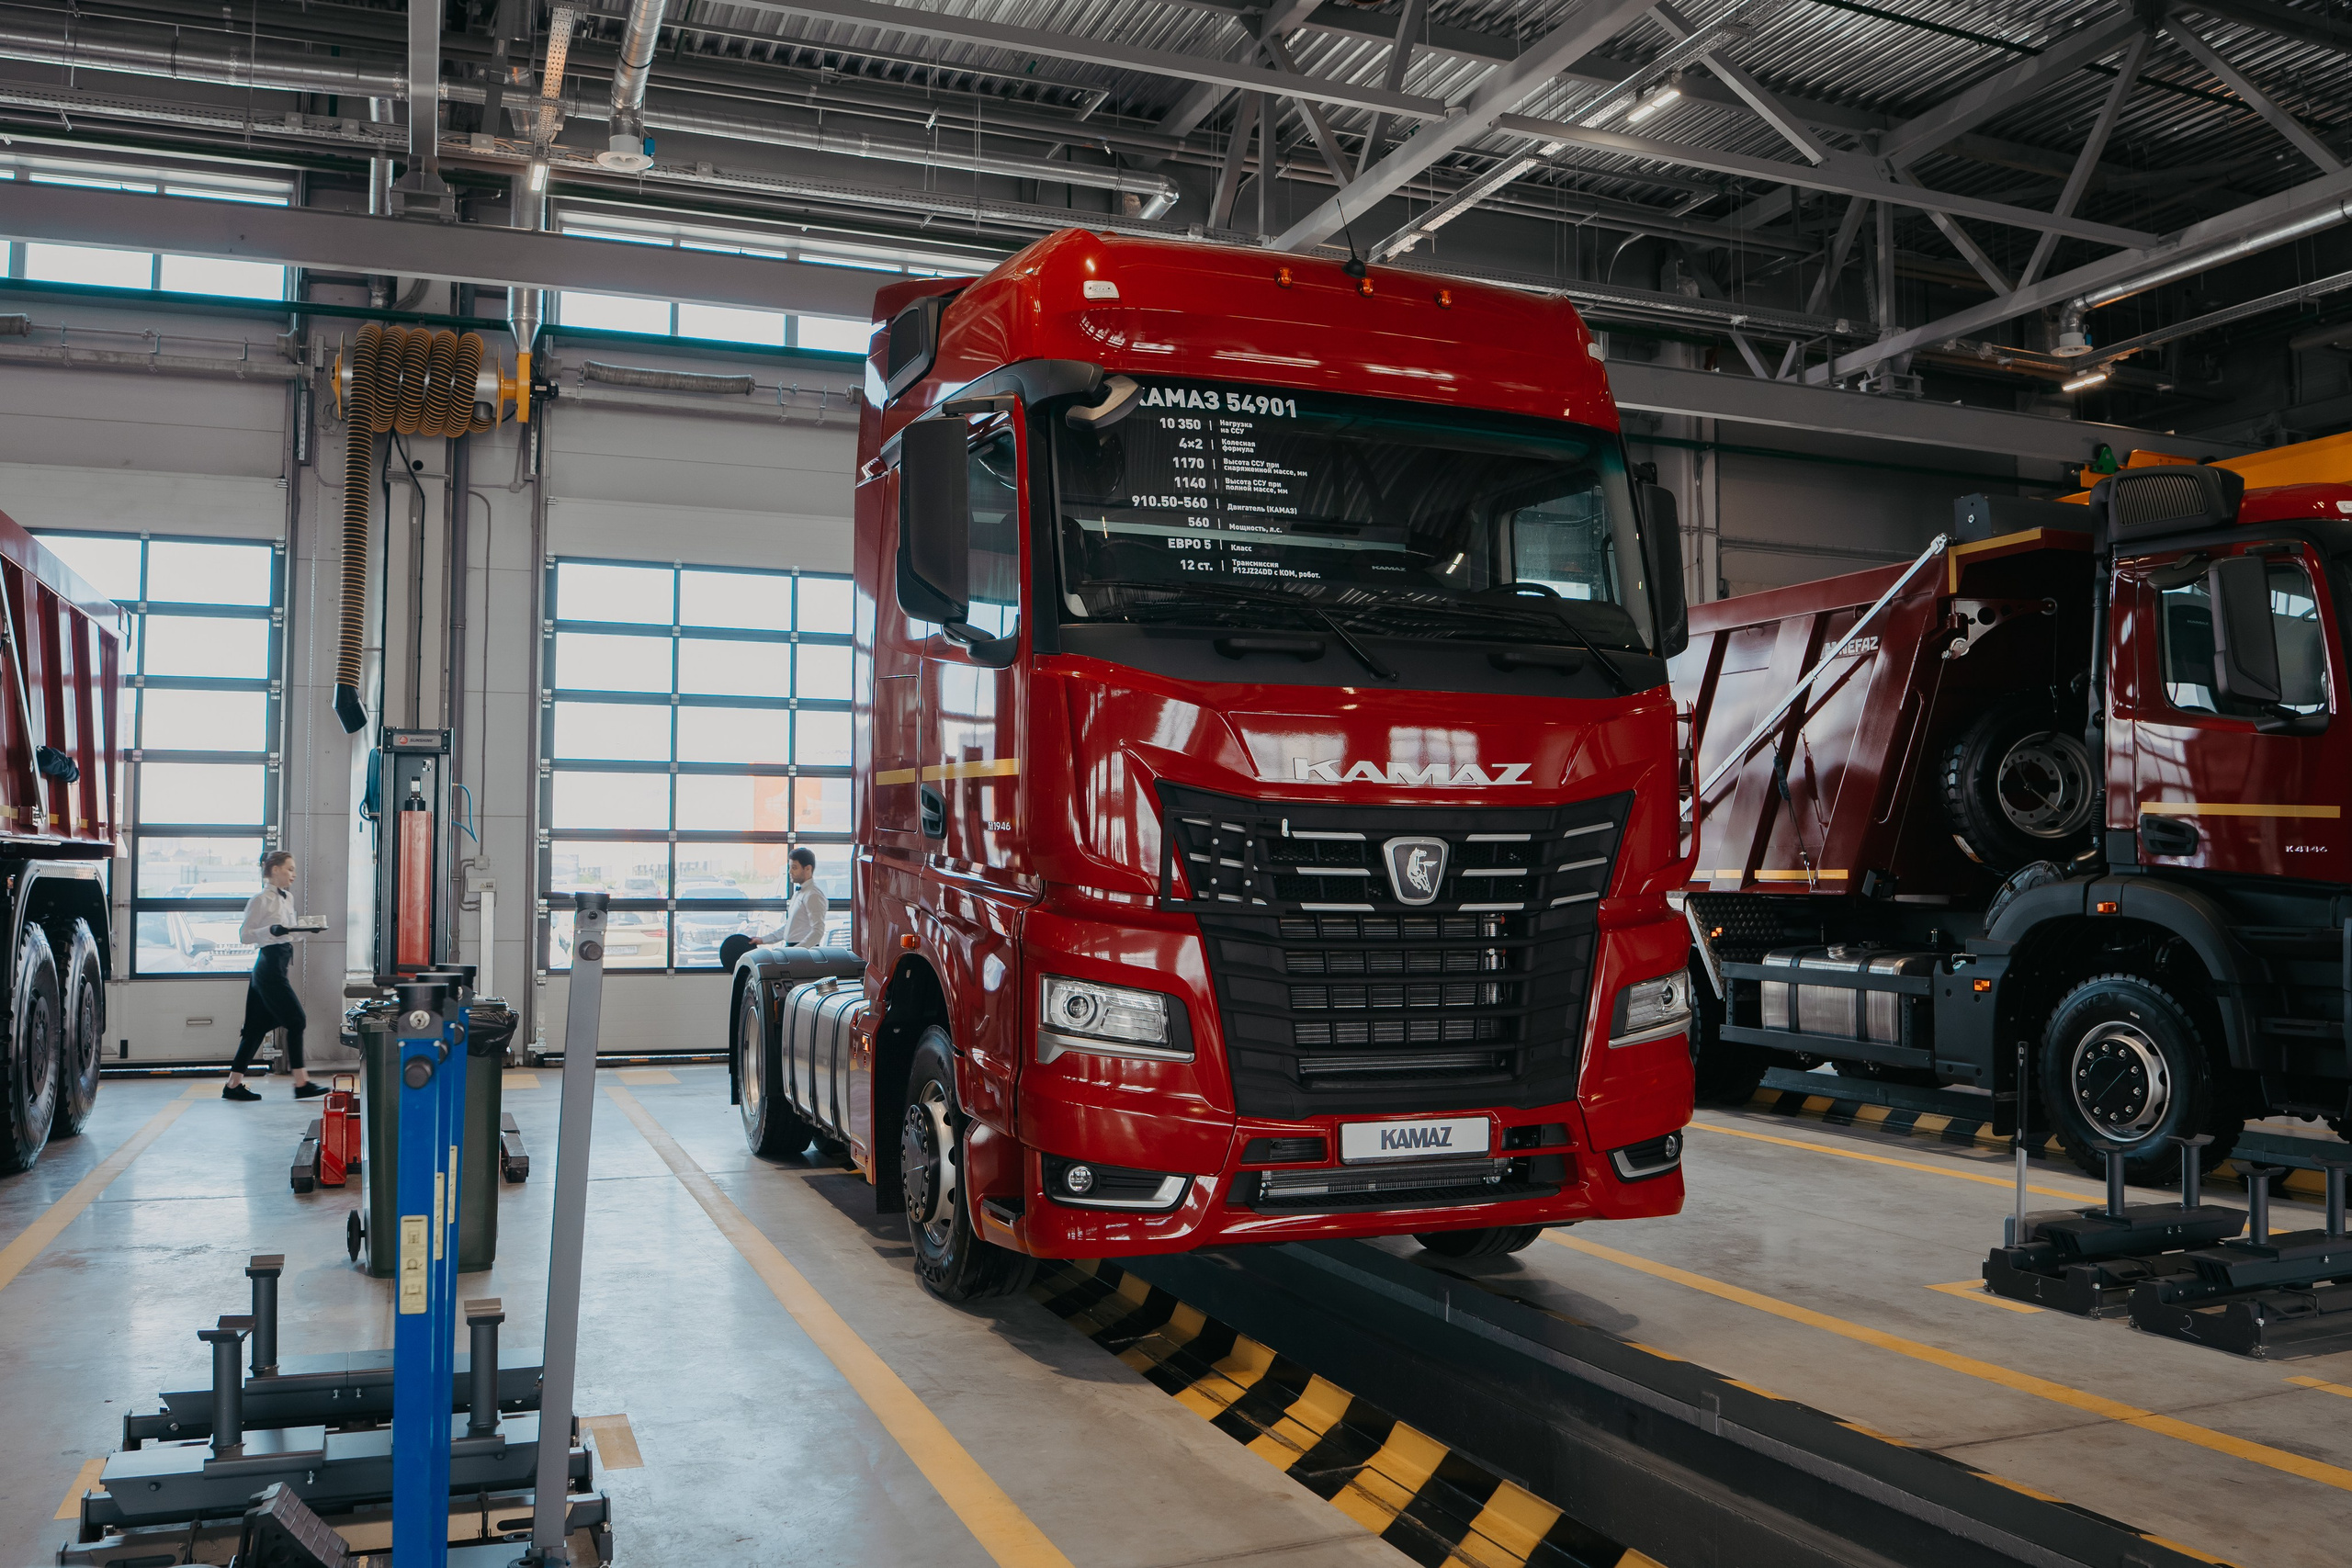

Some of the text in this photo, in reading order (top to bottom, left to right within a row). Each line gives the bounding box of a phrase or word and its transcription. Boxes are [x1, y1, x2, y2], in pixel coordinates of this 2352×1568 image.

[1226, 393, 1297, 418] 54901
[1160, 418, 1201, 430] 10 350
[1220, 420, 1253, 429] Нагрузка
[1222, 439, 1255, 447] Колесная
[1173, 457, 1204, 469] 1170
[1224, 465, 1272, 475] снаряженной
[1174, 477, 1206, 489] 1140
[1132, 495, 1208, 508] 910.50-560
[1227, 503, 1297, 515] Двигатель (КАМАЗ)
[1188, 517, 1209, 528] 560
[1229, 524, 1268, 533] Мощность,
[1168, 538, 1211, 550] ЕВРО 5
[1180, 560, 1213, 571] 12 ст.
[1232, 559, 1279, 568] Трансмиссия
[1294, 758, 1532, 784] KAMAZ
[1381, 1127, 1452, 1150] KAMAZ
[2180, 1315, 2200, 1339] 2
